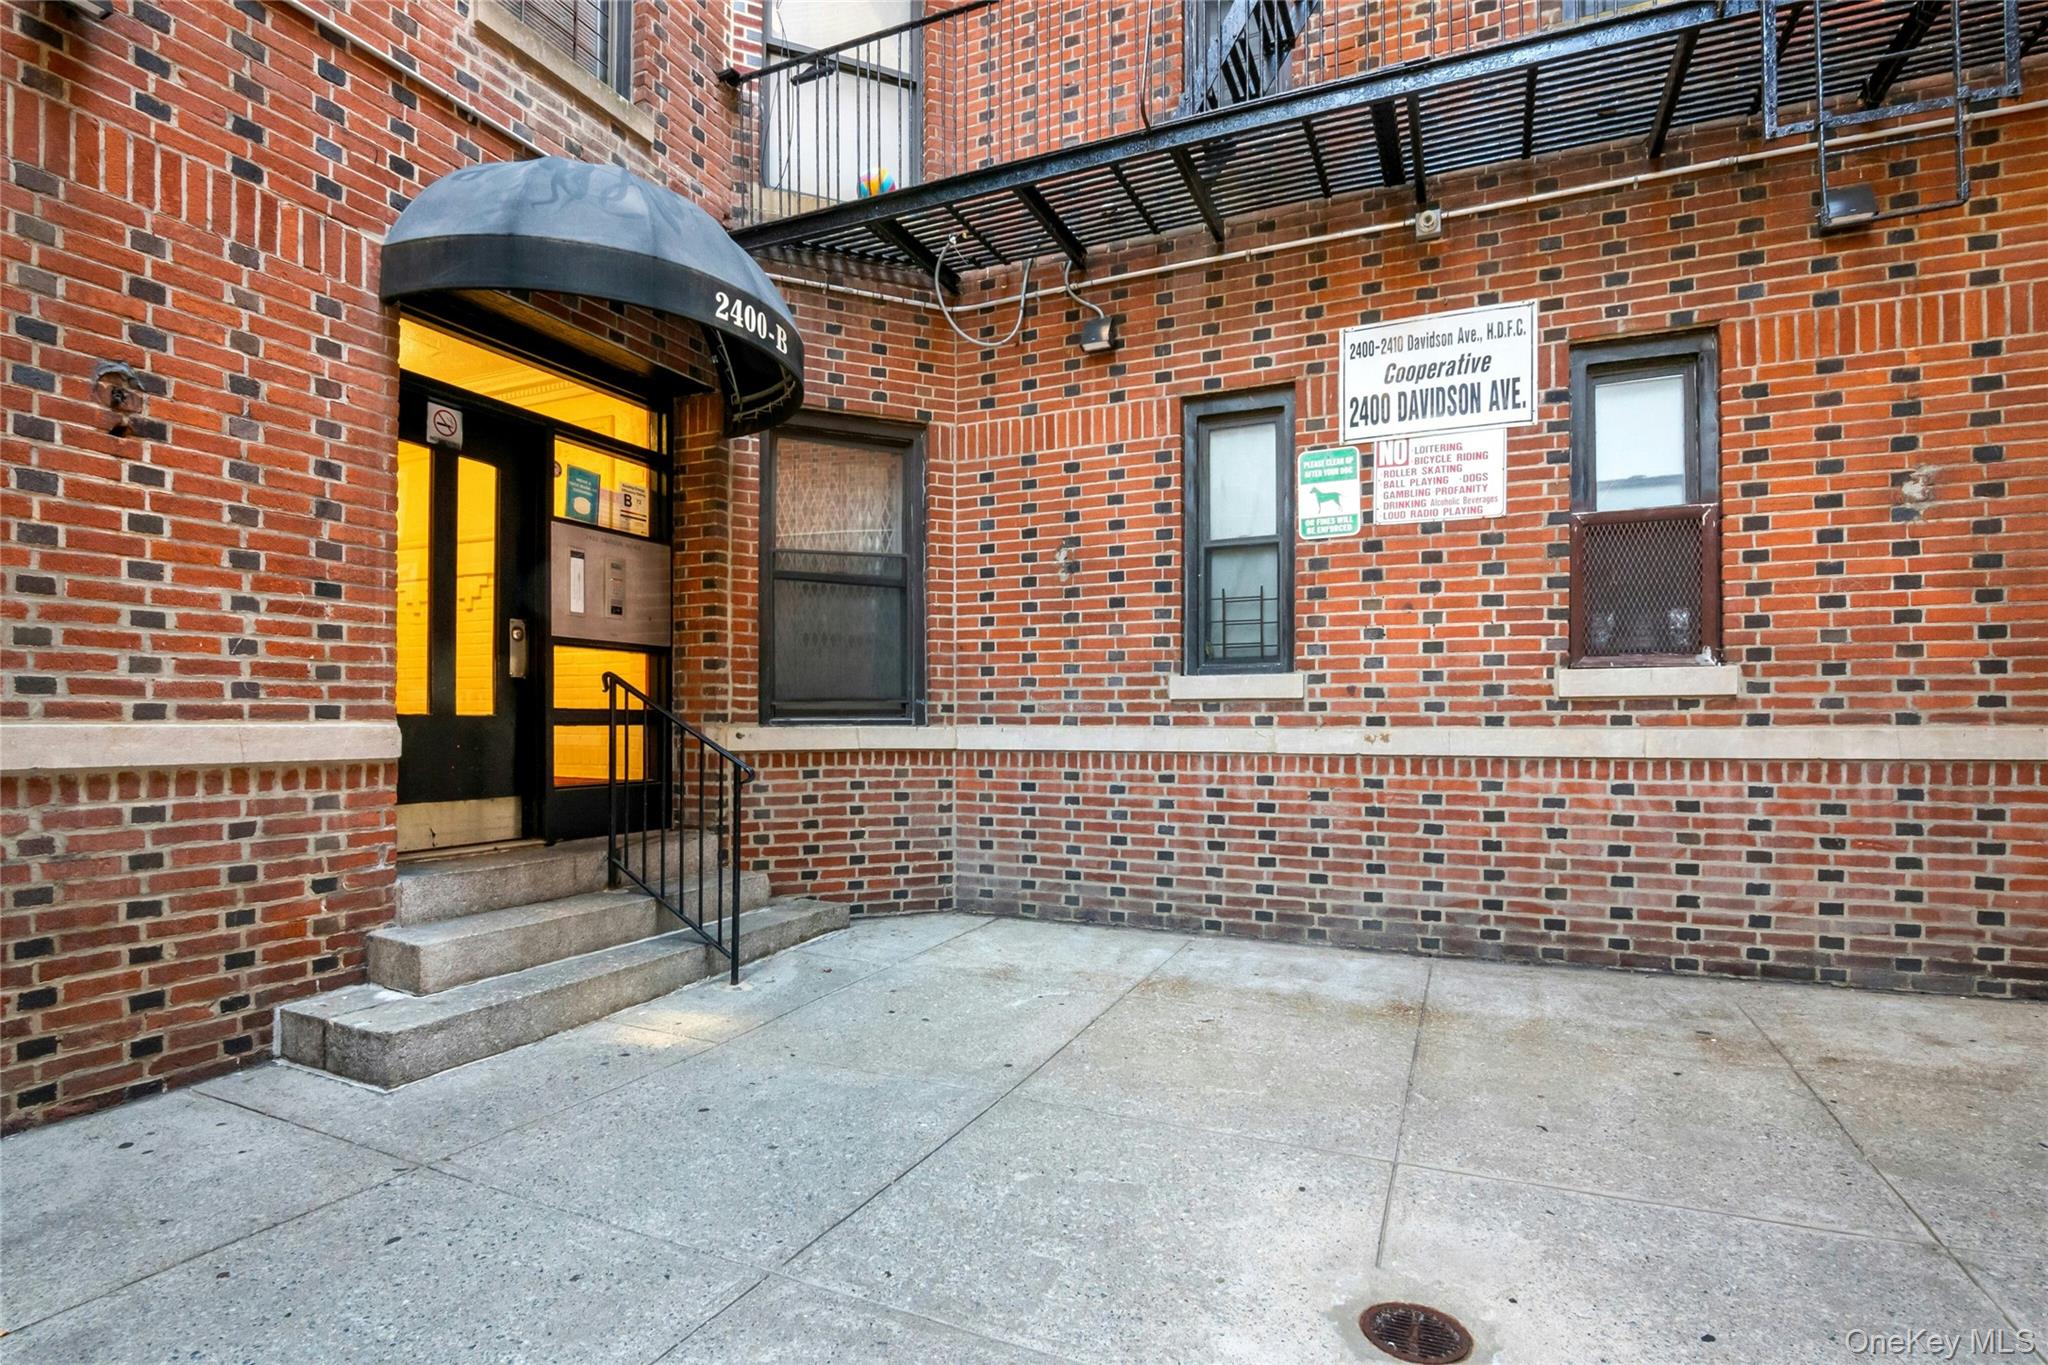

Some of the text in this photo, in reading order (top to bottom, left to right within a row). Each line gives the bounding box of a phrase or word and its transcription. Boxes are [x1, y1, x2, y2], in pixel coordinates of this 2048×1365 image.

[715, 291, 788, 354] 2400-B
[1350, 318, 1527, 360] 2400-2410 Davidson Ave., H.D.F.C.
[1384, 352, 1492, 385] Cooperative
[1350, 377, 1527, 428] 2400 DAVIDSON AVE.
[1379, 439, 1408, 465] NO
[1414, 442, 1463, 455] LOITERING
[1414, 451, 1489, 465] BICYCLE RIDING
[1383, 464, 1463, 478] ROLLER SKATING
[1383, 472, 1489, 489] BALL PLAYING DOGS
[1383, 484, 1488, 500] GAMBLING PROFANITY
[624, 493, 633, 508] B
[1383, 499, 1427, 510] DRINKING
[1462, 495, 1498, 506] Beverages
[1383, 505, 1483, 520] LOUD RADIO PLAYING
